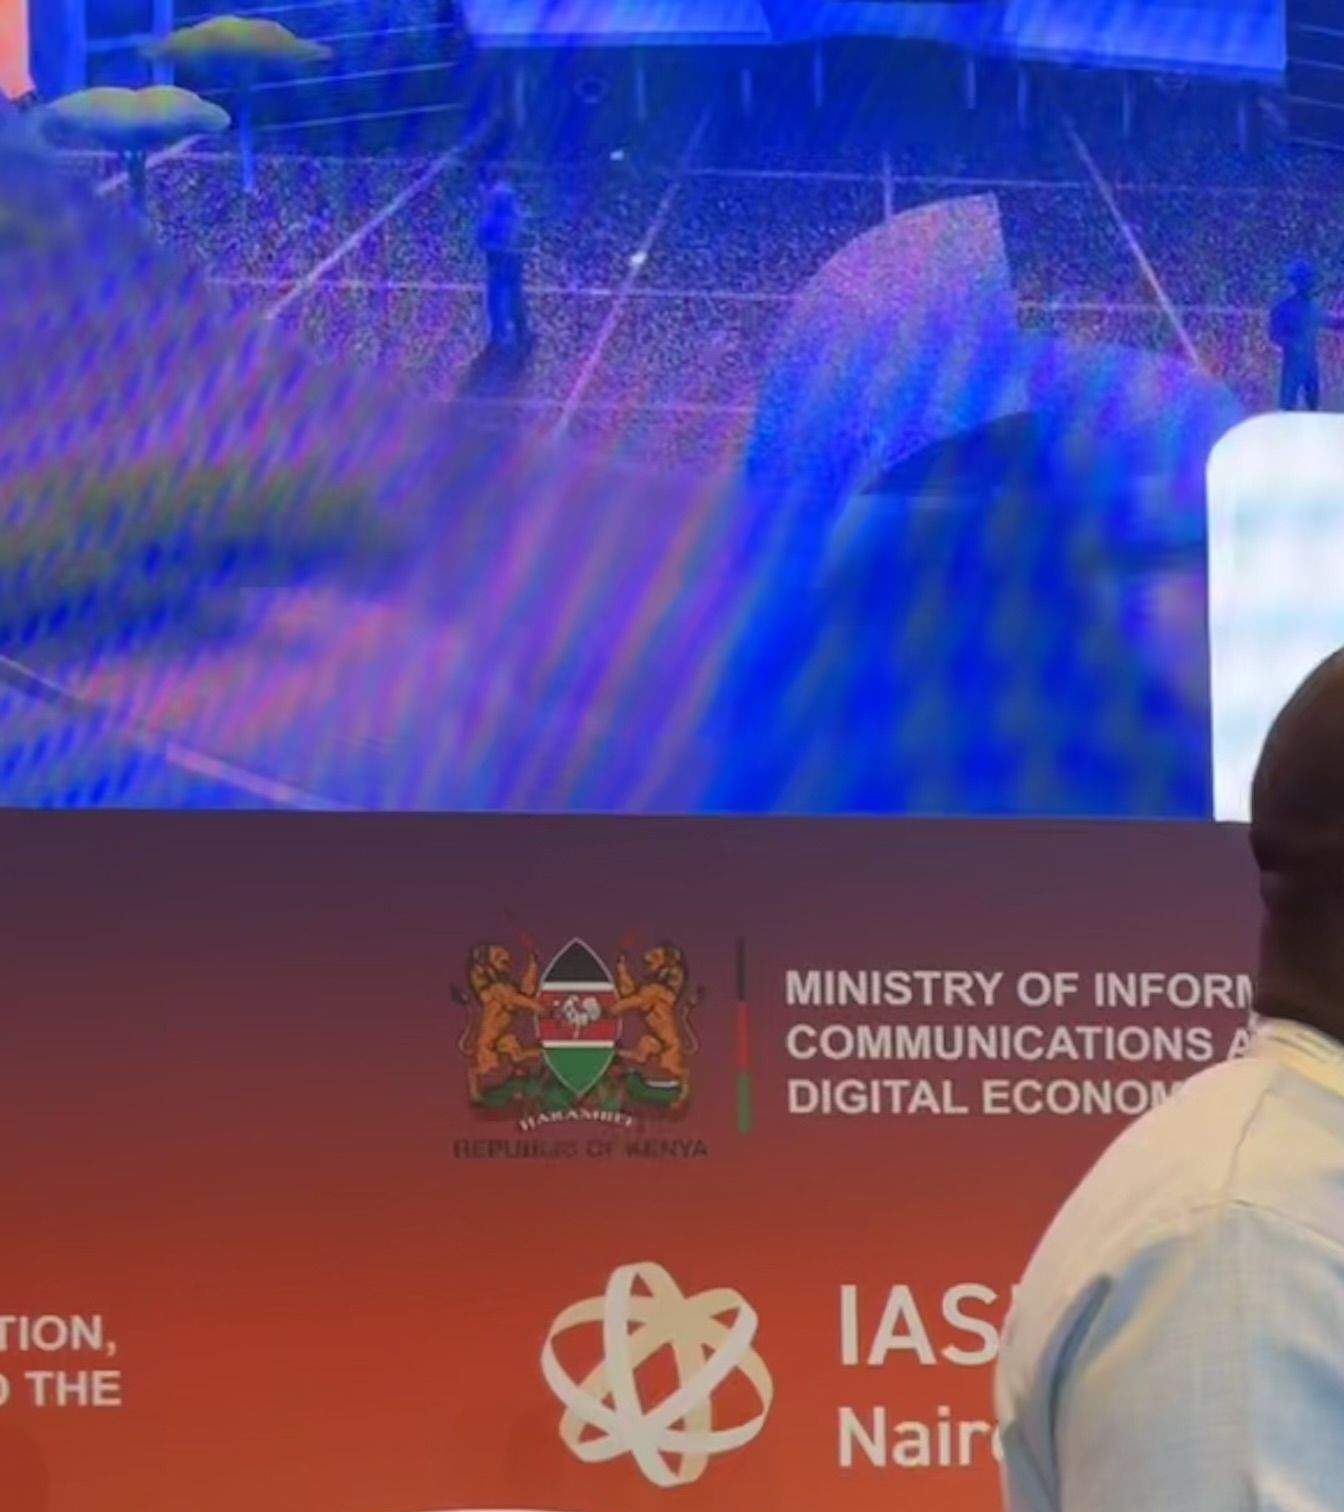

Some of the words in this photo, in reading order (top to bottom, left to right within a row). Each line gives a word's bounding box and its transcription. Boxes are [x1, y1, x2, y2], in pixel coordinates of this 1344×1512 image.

[785, 970, 1004, 1006] MINISTRY
[1017, 971, 1079, 1007] OF
[786, 1024, 1214, 1062] COMMUNICATIONS
[787, 1078, 969, 1115] DIGITAL
[453, 1138, 576, 1159] REPUBLIC
[626, 1138, 709, 1158] KENYA
[840, 1282, 1016, 1366] IAS
[23, 1369, 122, 1408] THE
